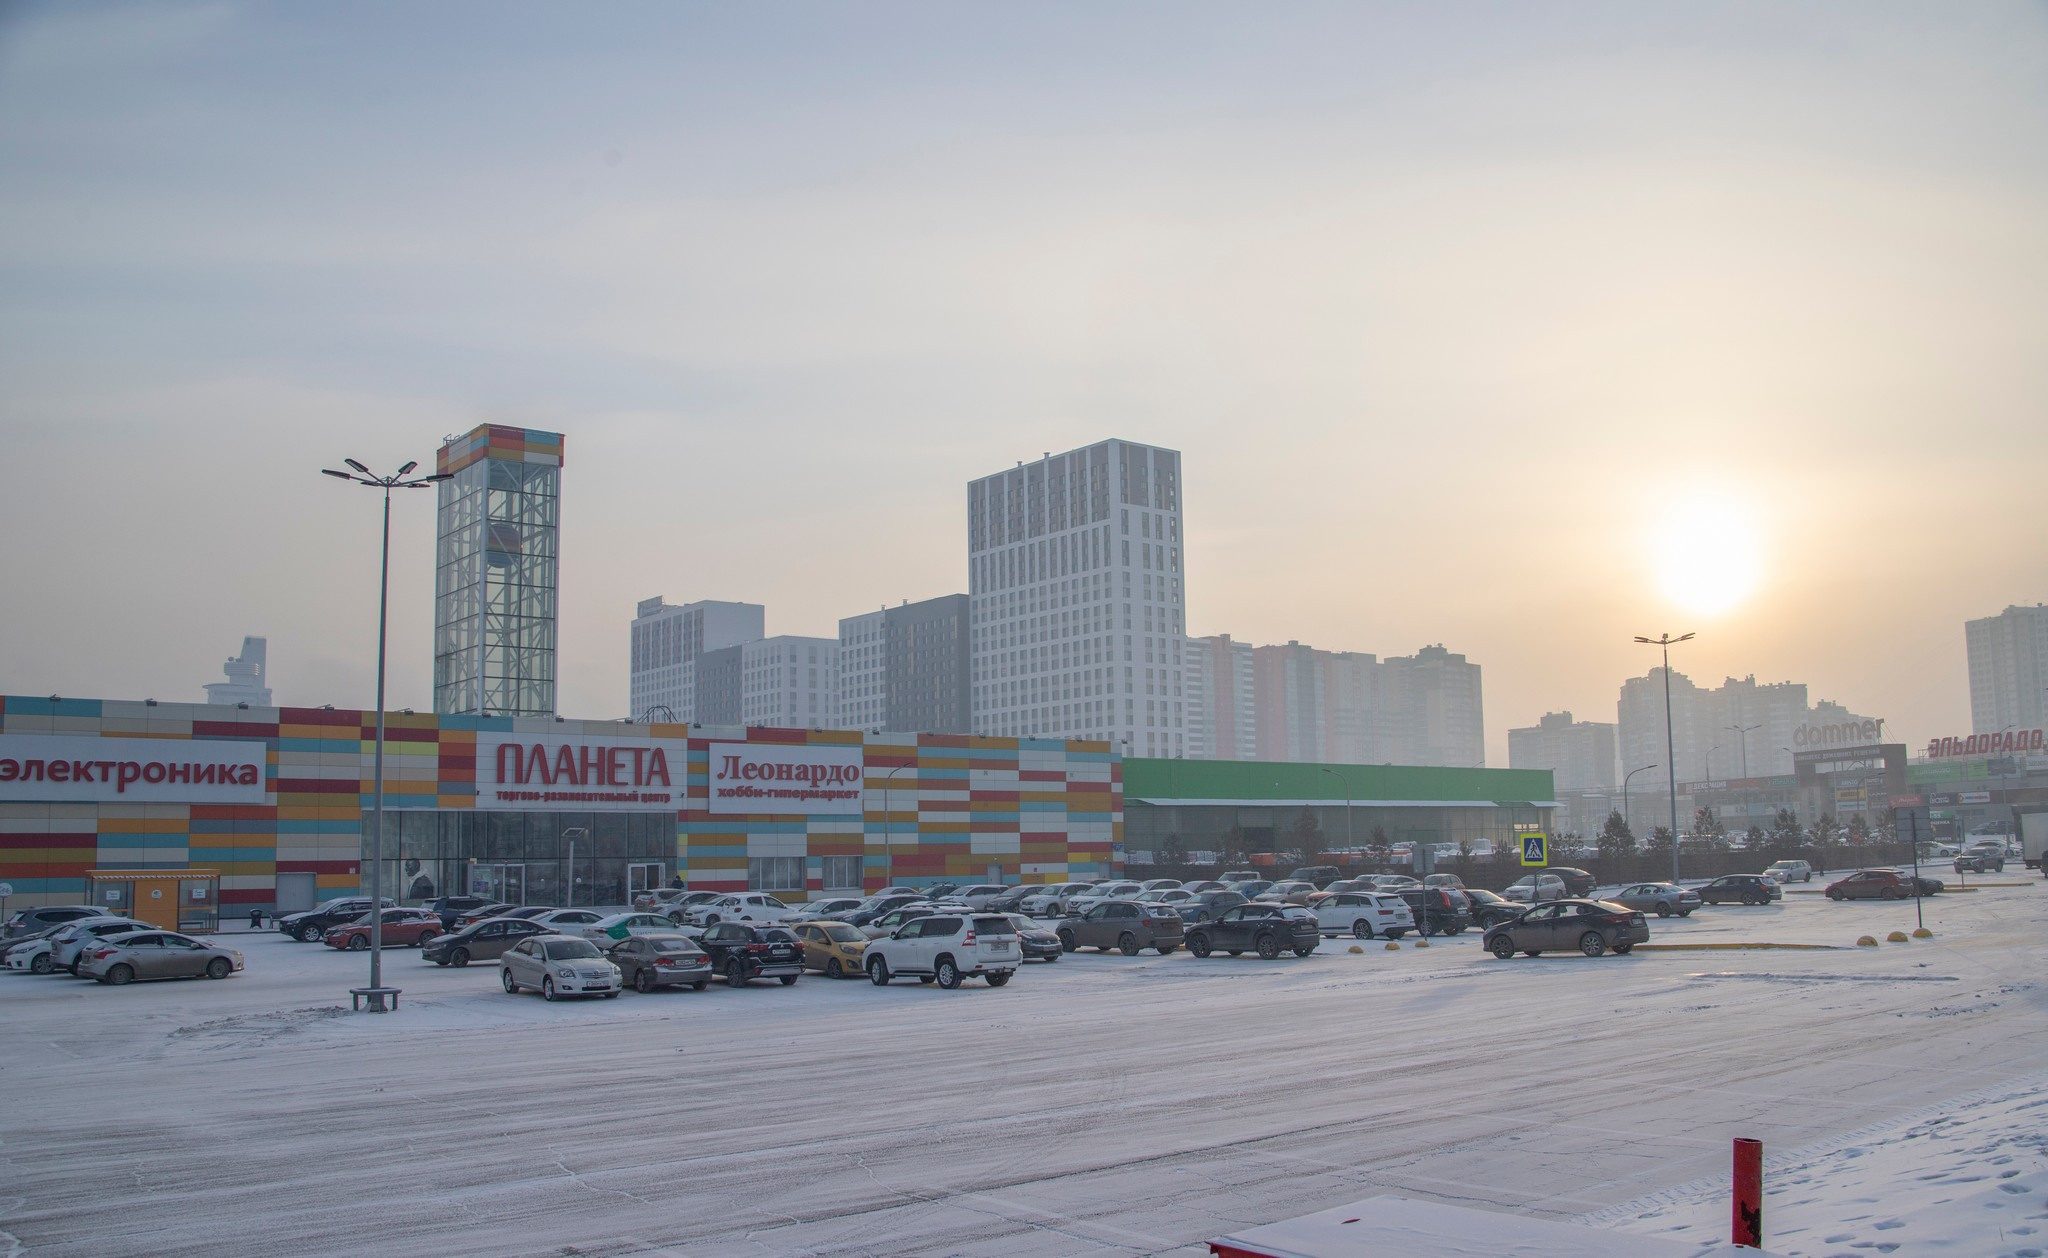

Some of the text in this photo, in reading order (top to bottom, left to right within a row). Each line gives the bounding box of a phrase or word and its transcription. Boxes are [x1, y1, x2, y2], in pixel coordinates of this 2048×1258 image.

[1793, 718, 1884, 746] dommer
[0, 758, 259, 793] электроника
[497, 743, 671, 786] ПЛАНЕТА
[717, 755, 860, 788] Леонардо
[496, 790, 671, 804] торгово-развлекательный центр
[717, 785, 860, 801] хобби-гипермаркет
